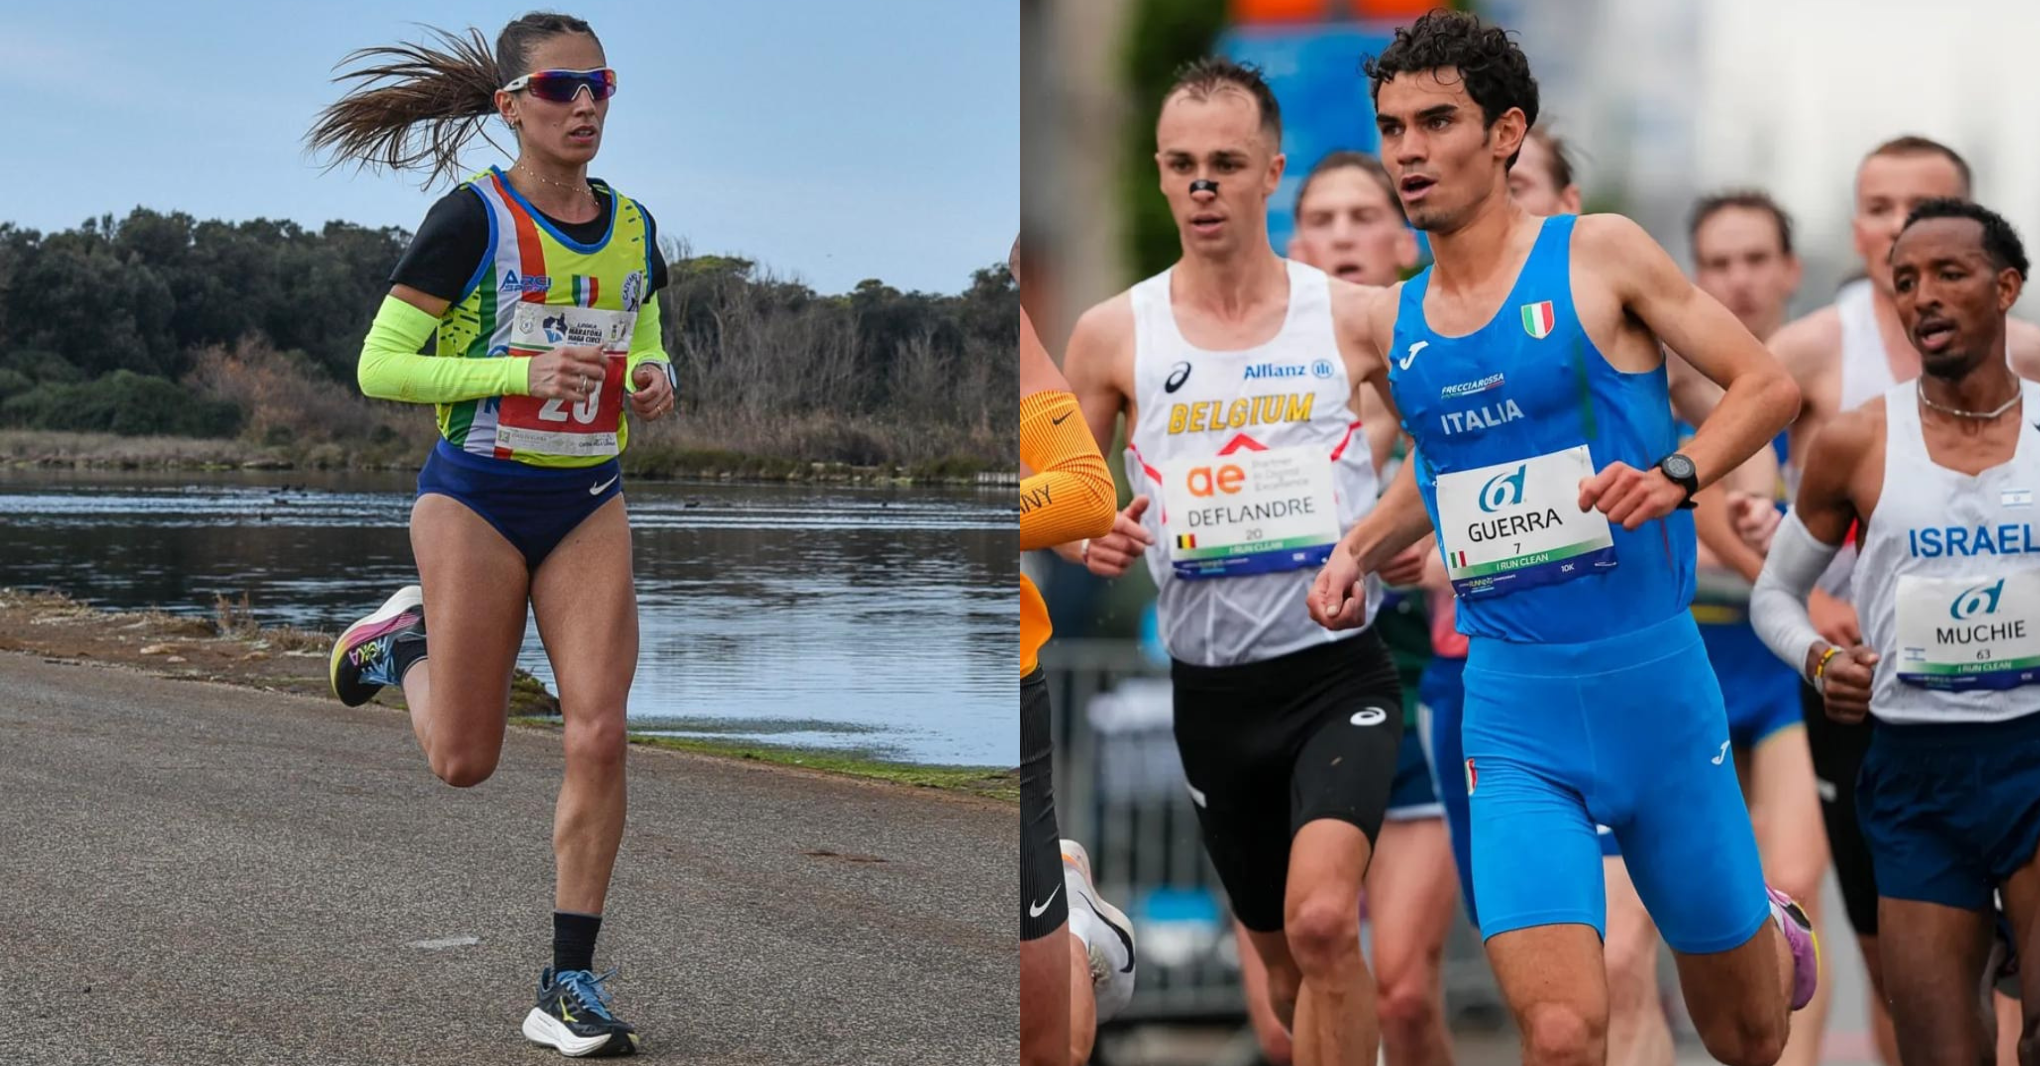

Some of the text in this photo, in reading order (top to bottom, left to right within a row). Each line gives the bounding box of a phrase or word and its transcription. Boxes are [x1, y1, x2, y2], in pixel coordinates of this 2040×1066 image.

[568, 327, 602, 337] MARATONA
[1244, 363, 1306, 380] Allianz
[1441, 373, 1504, 396] FRECCIAROSSA
[1167, 392, 1315, 435] BELGIUM
[1440, 398, 1525, 436] ITALIA
[1186, 463, 1246, 498] ae
[1188, 497, 1316, 528] DEFLANDRE
[1246, 528, 1263, 541] 20
[1468, 508, 1563, 542] GUERRA
[1513, 543, 1521, 554] 7
[1909, 524, 2040, 558] ISRAEL
[1501, 559, 1520, 569] RUN
[1520, 553, 1549, 566] CLEAN
[1936, 619, 2027, 645] MUCHIE
[1976, 649, 1991, 660] 63
